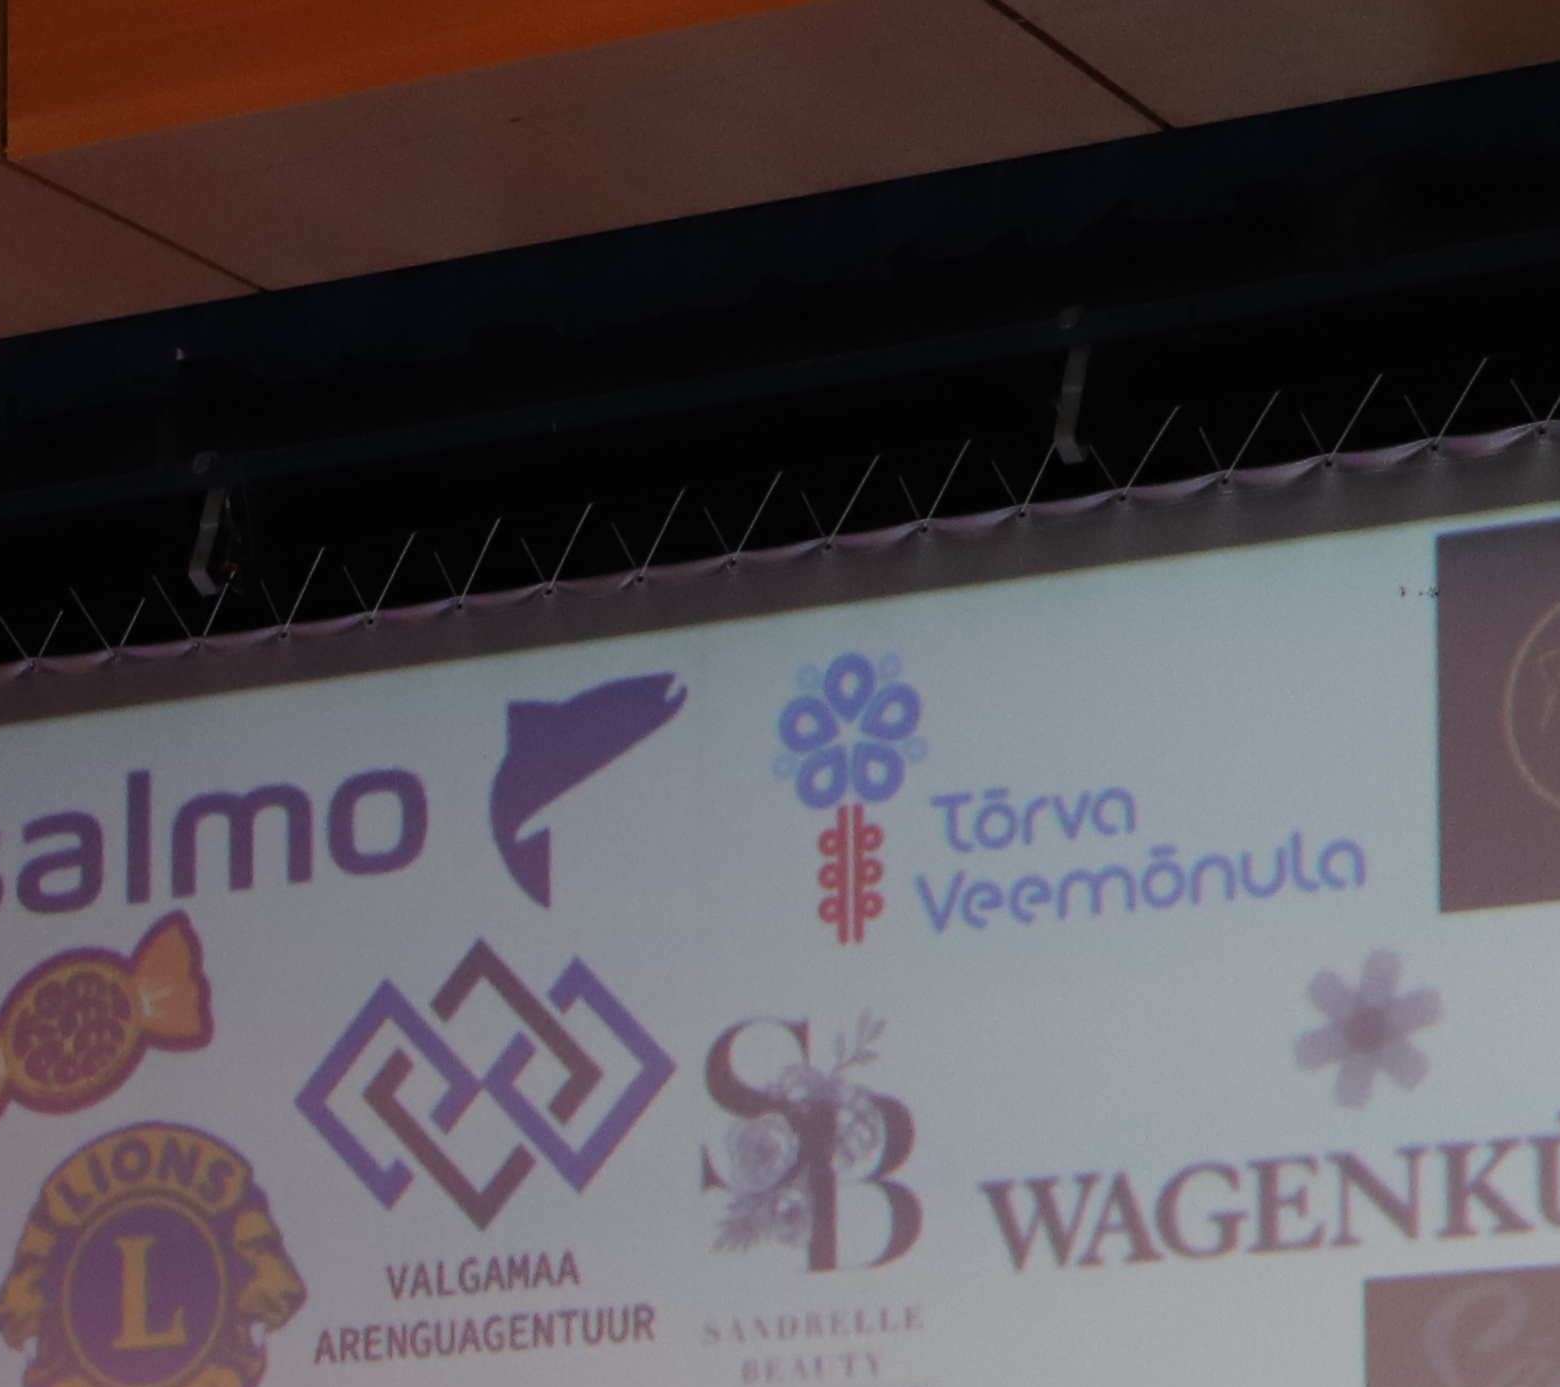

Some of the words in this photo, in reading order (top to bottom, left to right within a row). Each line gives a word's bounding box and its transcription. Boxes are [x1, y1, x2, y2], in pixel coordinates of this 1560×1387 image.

[927, 785, 1141, 855] Tõrva
[912, 829, 1369, 935] Veemõnula
[54, 1136, 236, 1215] LIONS
[111, 1234, 189, 1350] L
[384, 1248, 582, 1301] VALGAMAA
[314, 1301, 658, 1366] ARENGUAGENTUUR
